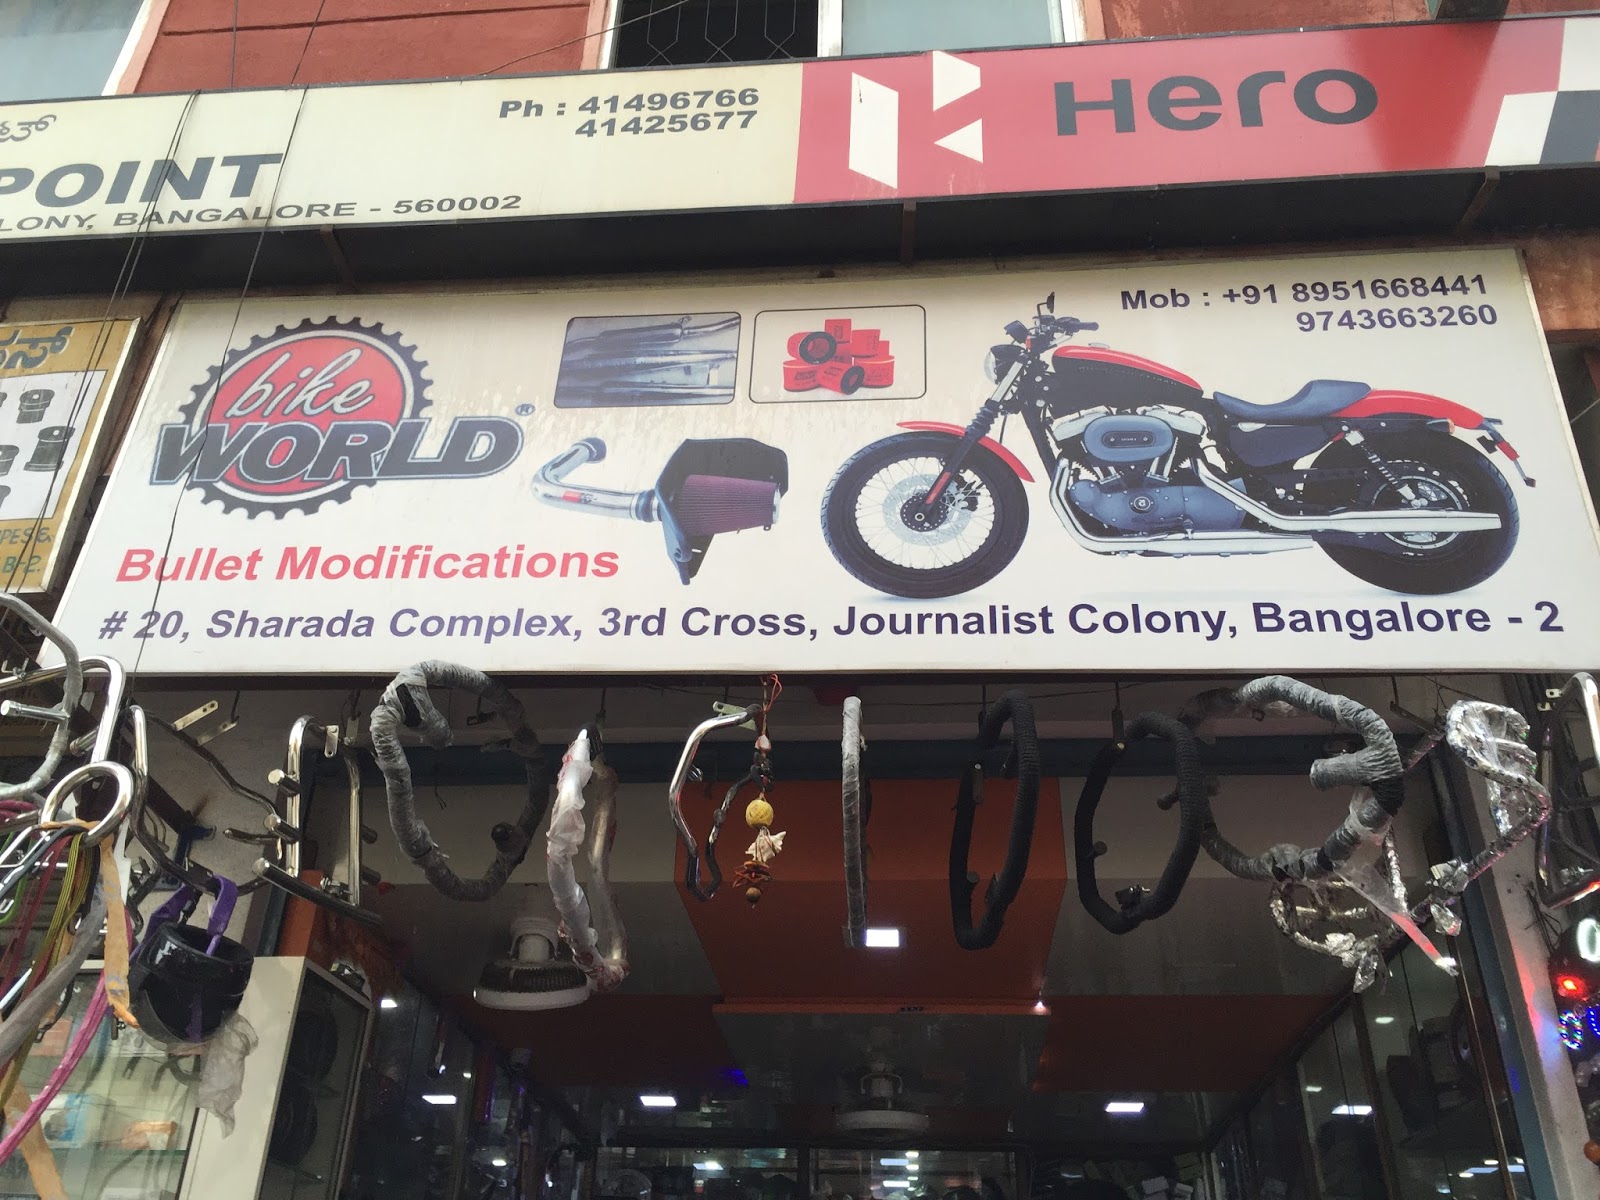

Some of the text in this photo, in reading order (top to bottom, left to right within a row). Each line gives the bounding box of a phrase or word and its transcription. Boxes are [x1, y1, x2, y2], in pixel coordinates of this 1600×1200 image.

[499, 88, 759, 118] Ph : 41496766
[575, 110, 757, 137] 41425677
[0, 153, 283, 208] POINT
[113, 200, 357, 227] BANGALORE
[393, 195, 522, 214] 560002
[1121, 274, 1488, 310] Mob : +91 8951668441
[1295, 303, 1498, 332] 9743663260
[225, 346, 375, 419] bike
[149, 415, 525, 486] WORLD
[115, 543, 619, 582] Bullet Modifications
[98, 611, 128, 639] #
[133, 610, 190, 645] 20,
[206, 608, 374, 639] Sharada
[390, 607, 582, 645] Complex,
[599, 608, 667, 637] 3rd
[682, 607, 818, 642] Cross,
[833, 605, 1055, 636] Journalist
[1068, 603, 1238, 641] Colony,
[1252, 602, 1492, 641] Bangalore
[1534, 601, 1565, 633] 2
